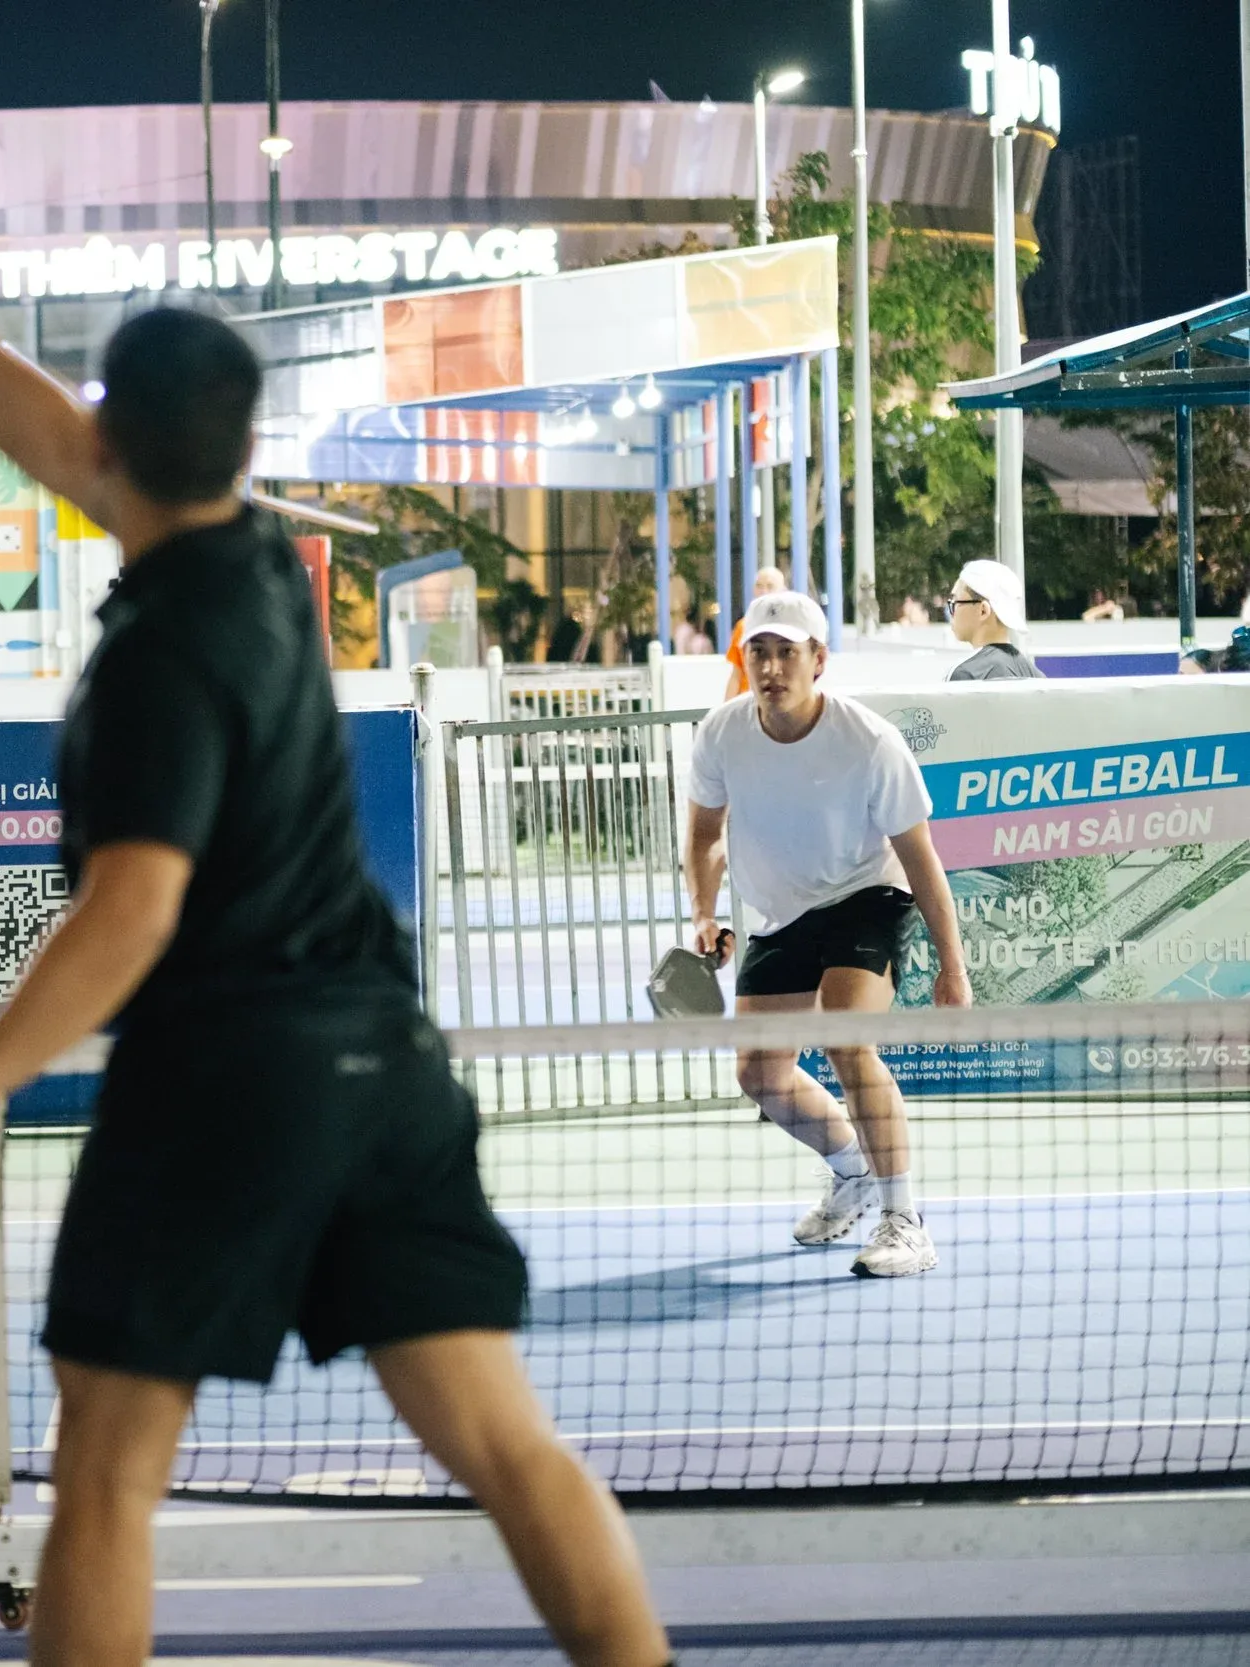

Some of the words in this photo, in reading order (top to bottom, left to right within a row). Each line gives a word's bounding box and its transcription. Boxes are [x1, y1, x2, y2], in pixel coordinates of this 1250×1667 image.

[178, 228, 559, 289] RIVERSTAGE
[12, 778, 58, 801] GIẢI
[955, 744, 1240, 811] PICKLEBALL
[993, 820, 1071, 857] NAM
[1077, 808, 1134, 844] SÀI
[1143, 803, 1214, 841] GÒN
[958, 895, 996, 922] UY
[1006, 891, 1050, 921] MÔ
[963, 928, 1039, 970] UỐC
[908, 1043, 946, 1055] D-JOY
[950, 1043, 979, 1053] Nam
